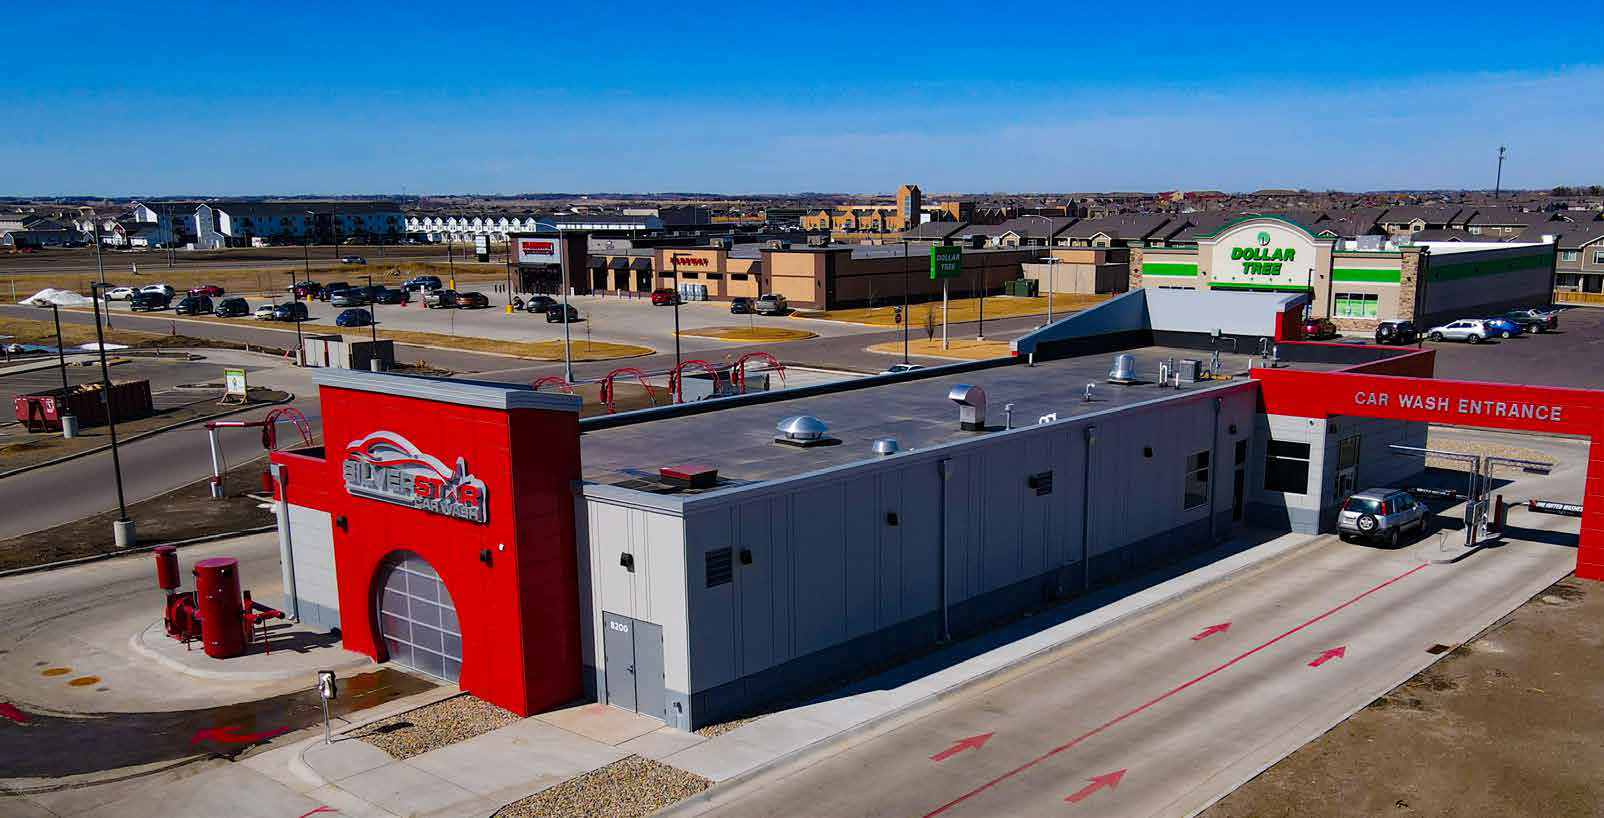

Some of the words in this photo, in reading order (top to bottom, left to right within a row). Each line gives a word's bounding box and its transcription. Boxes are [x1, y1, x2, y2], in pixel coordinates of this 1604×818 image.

[1231, 247, 1296, 261] DOLLAR
[1242, 261, 1283, 276] TREE
[1354, 391, 1390, 406] CAR
[1399, 393, 1450, 412] WASH
[1458, 399, 1563, 421] ENTRANCE
[413, 498, 439, 513] CAR
[440, 500, 480, 521] WASH
[610, 620, 629, 633] 8200
